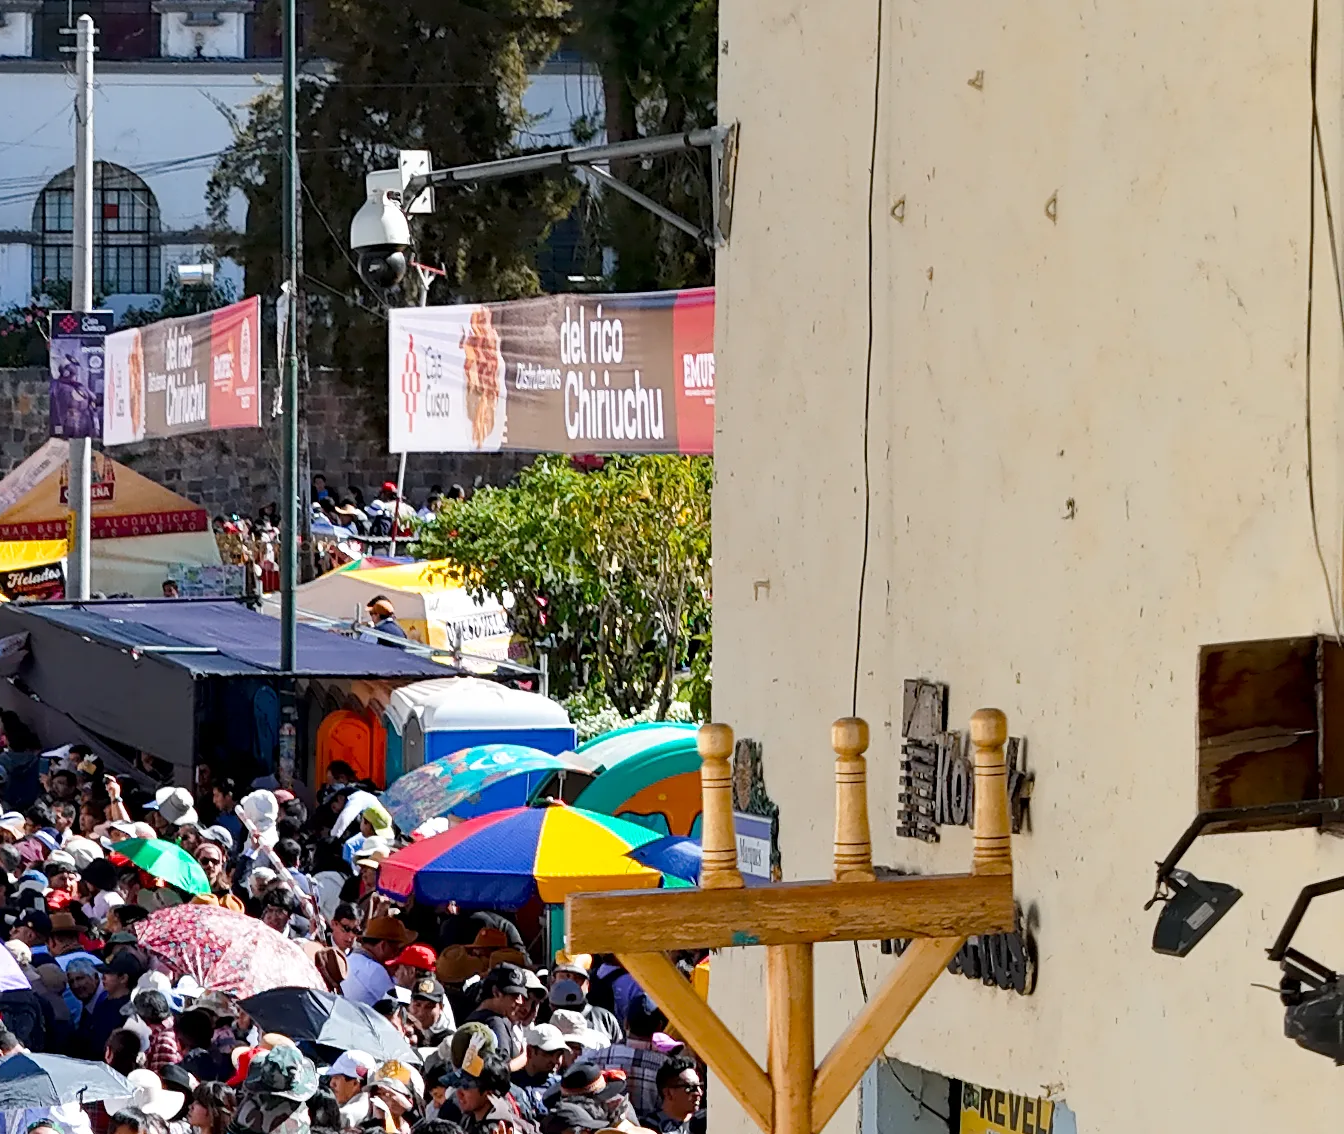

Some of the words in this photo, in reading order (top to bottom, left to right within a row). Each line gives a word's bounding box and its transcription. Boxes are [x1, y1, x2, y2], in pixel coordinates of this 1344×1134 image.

[561, 305, 586, 365] del
[590, 304, 624, 364] rico
[564, 370, 665, 441] Chiriuchu
